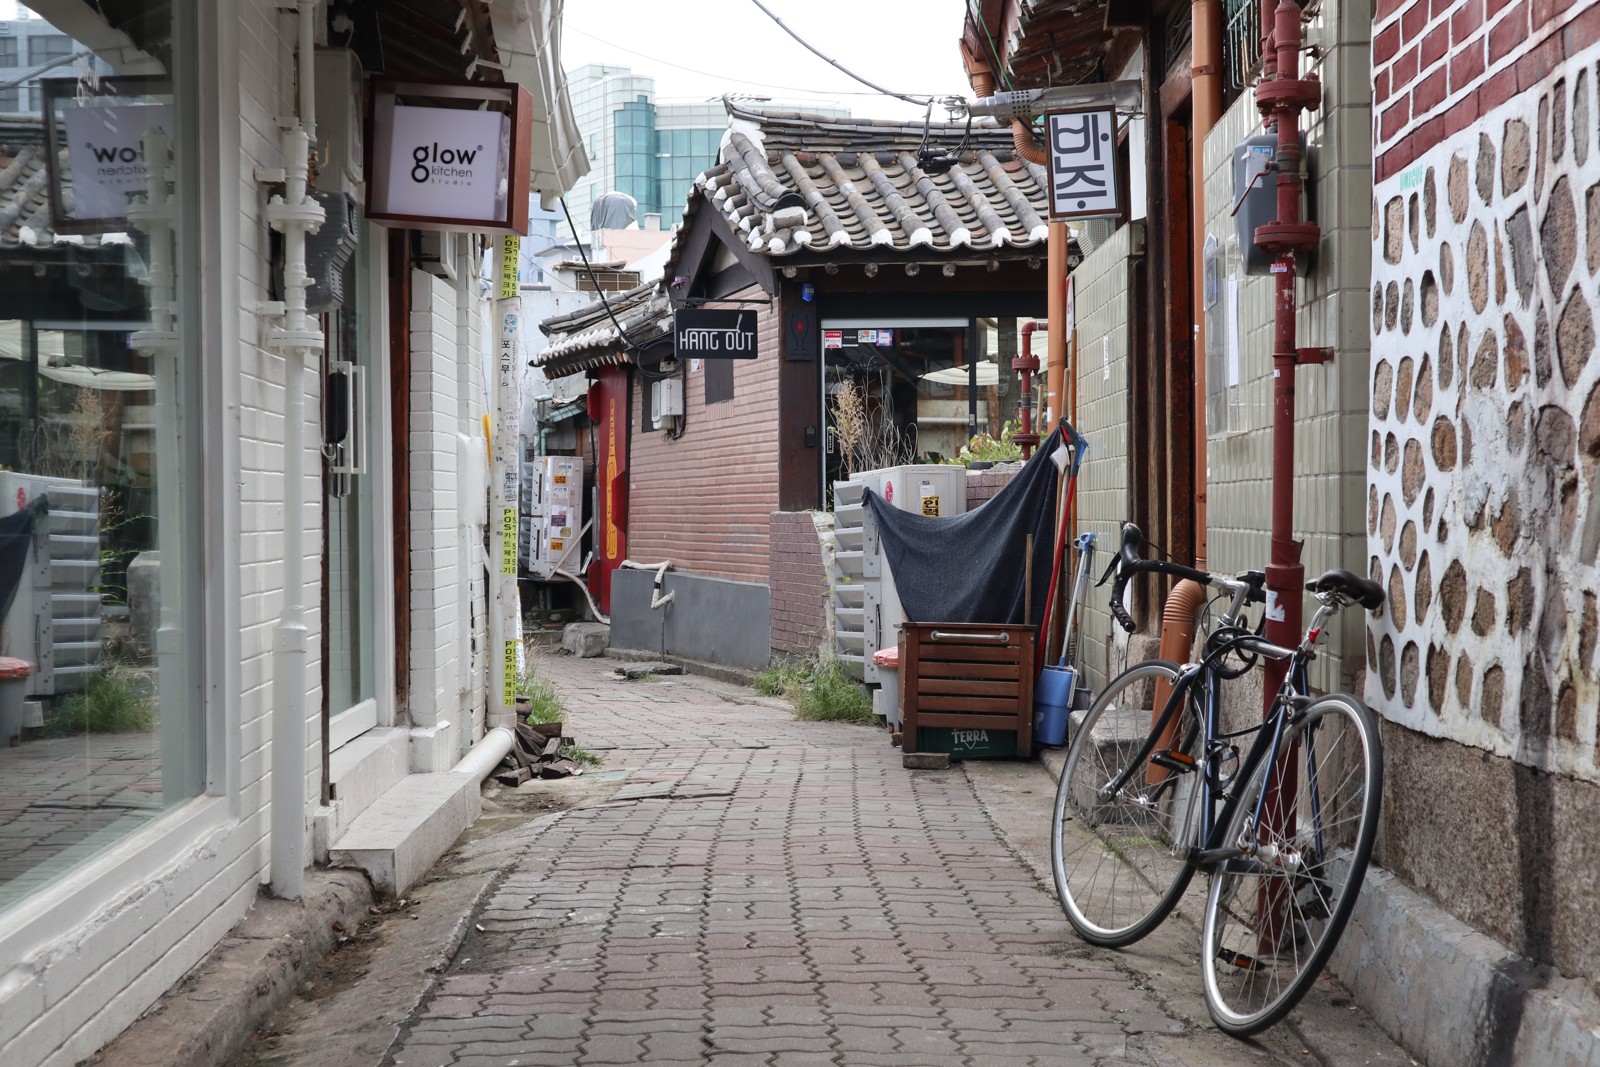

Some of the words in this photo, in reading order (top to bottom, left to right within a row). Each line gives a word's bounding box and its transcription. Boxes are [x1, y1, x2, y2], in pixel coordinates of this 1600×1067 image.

[431, 166, 473, 178] kitchen
[680, 328, 719, 350] HANG
[725, 329, 754, 350] OUT
[951, 729, 989, 744] TERRA
